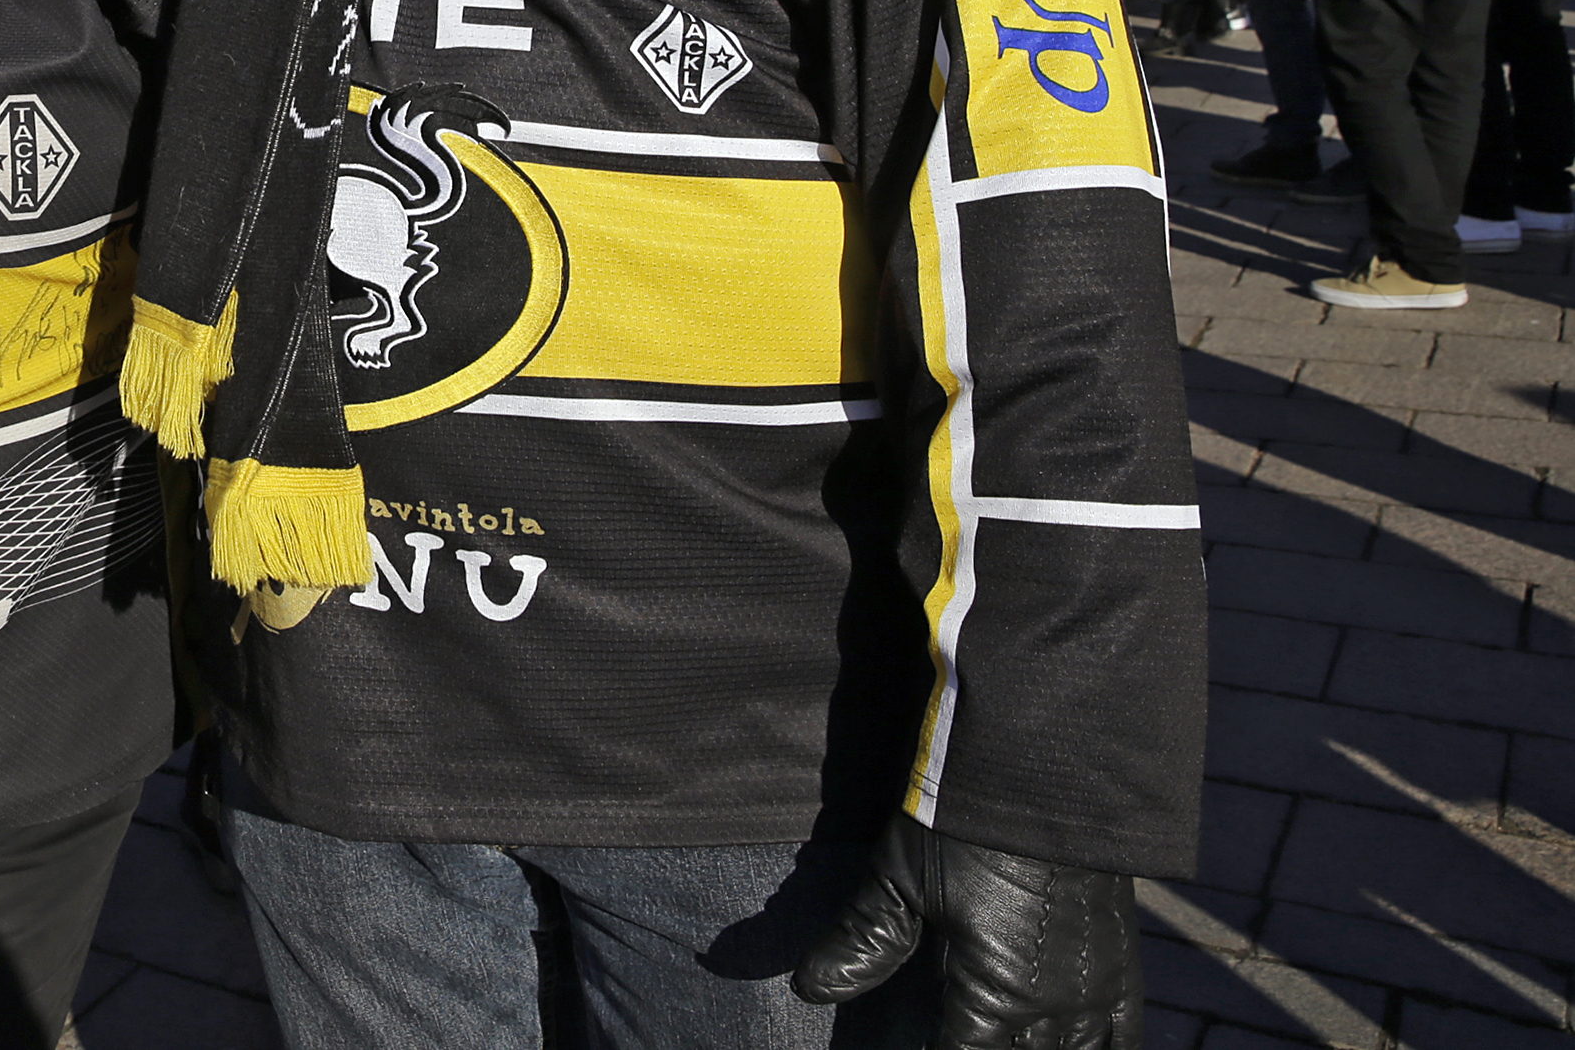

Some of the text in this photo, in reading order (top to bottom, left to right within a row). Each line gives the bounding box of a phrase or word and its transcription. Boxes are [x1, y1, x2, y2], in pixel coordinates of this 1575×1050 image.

[680, 18, 706, 104] ACKLA
[13, 106, 36, 209] TACKLA
[368, 496, 546, 536] avintola
